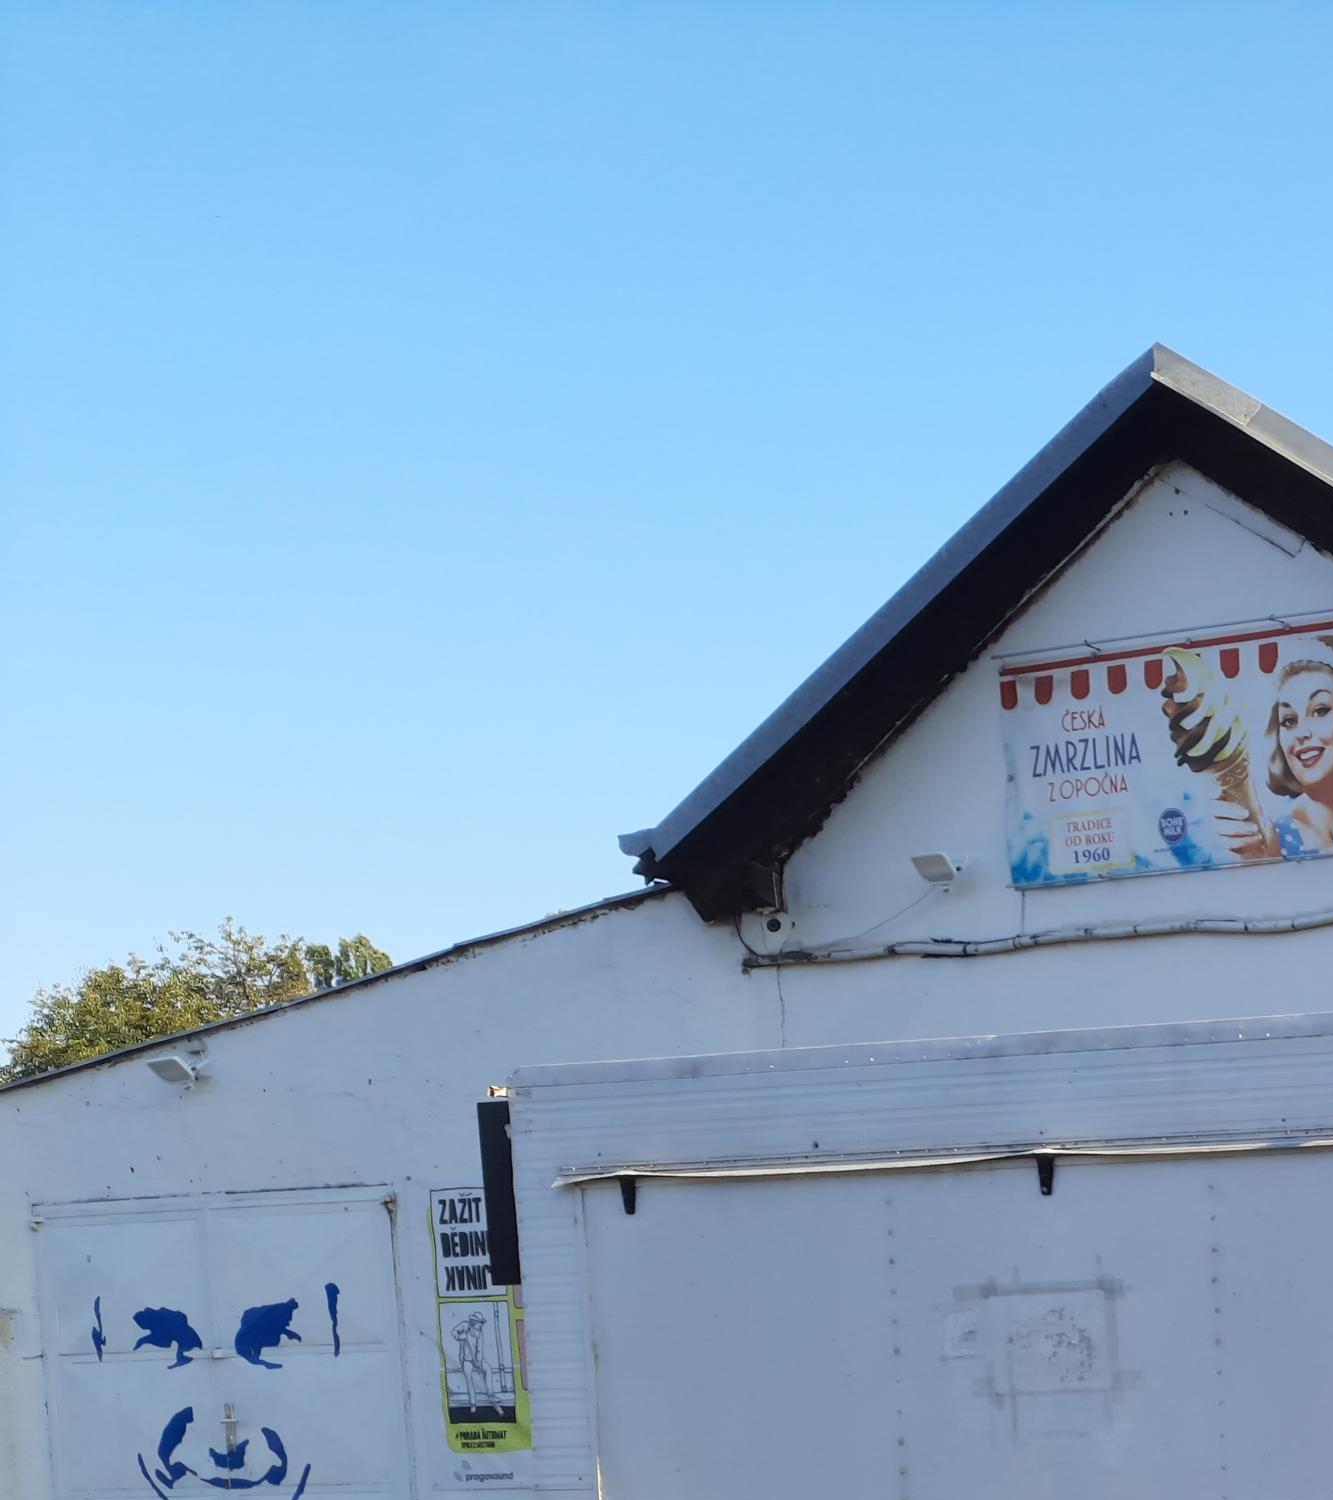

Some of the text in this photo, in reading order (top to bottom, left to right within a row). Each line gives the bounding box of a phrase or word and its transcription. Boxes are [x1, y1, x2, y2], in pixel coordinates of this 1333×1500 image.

[1061, 705, 1106, 733] ČESKÁ
[1030, 732, 1142, 778] ZMRZLINA
[1048, 771, 1129, 802] Z OPOČNA
[1066, 817, 1113, 833] TRADICE
[1065, 832, 1116, 848] OD ROKU
[1074, 847, 1111, 864] 1960
[438, 1192, 481, 1224] ZAŽÍT
[440, 1226, 488, 1258] DĚDIN
